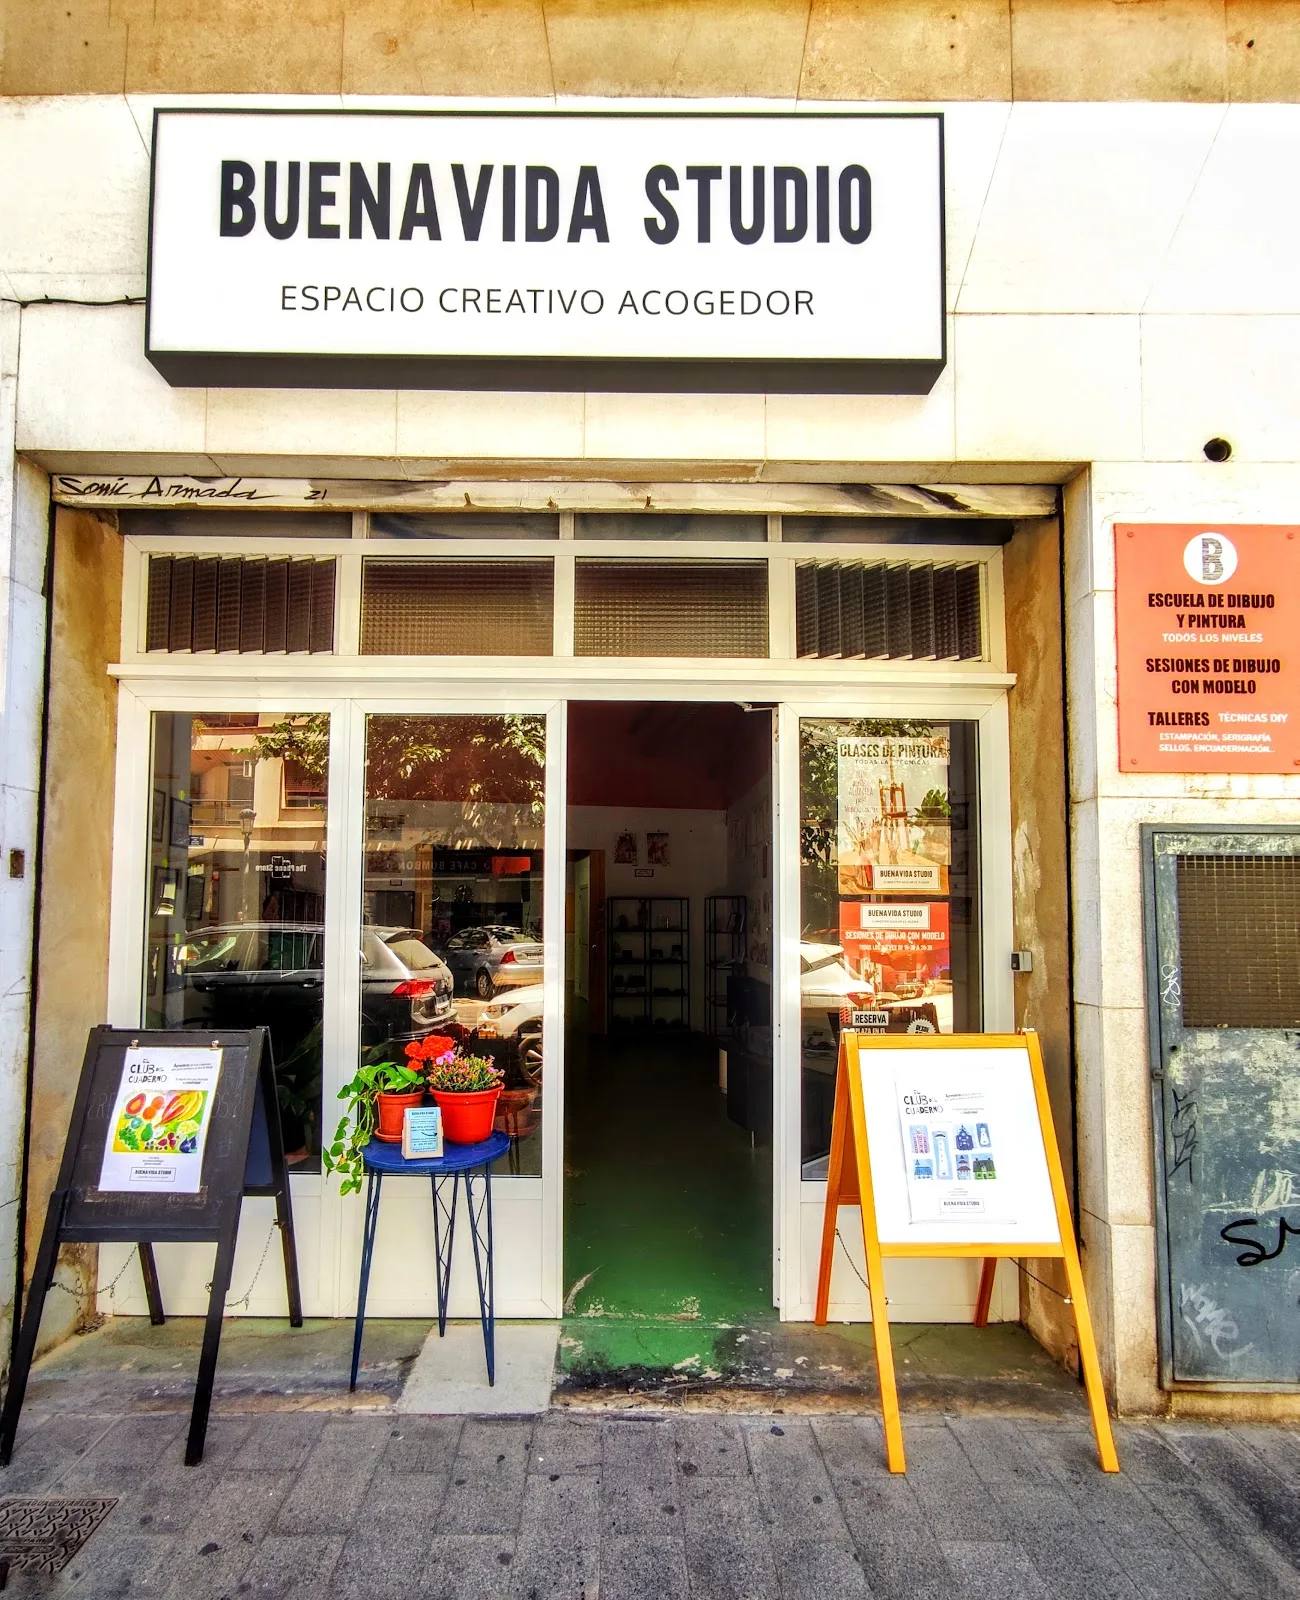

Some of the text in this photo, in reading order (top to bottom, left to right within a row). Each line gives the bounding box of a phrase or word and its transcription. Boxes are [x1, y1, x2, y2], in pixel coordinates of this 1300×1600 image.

[219, 159, 874, 246] BUENAVIDA STUDIO
[281, 285, 815, 316] ESPACIO CREATIVO ACOGEDOR
[1201, 537, 1224, 581] B
[1148, 593, 1275, 609] ESCUELA DE DIBUJO
[1176, 614, 1246, 629] Y PINTURA
[1162, 633, 1263, 643] TODOS LOS NIVELES
[1146, 658, 1281, 674] SESIONES DE DIBUJO
[1172, 680, 1256, 694] CON MODELO
[1148, 711, 1288, 727] TALLERES TÉCNICAS DIY
[840, 744, 880, 757] CLASES
[882, 745, 896, 758] DE
[880, 870, 933, 878] BUENAVIDA STUDIO
[868, 909, 901, 917] BUENAVIDA
[921, 932, 945, 940] MODELO
[855, 1014, 887, 1024] RESERVA
[130, 1064, 155, 1074] CLUB
[128, 1075, 168, 1083] CUADERNO
[903, 1094, 929, 1106] CLUB
[905, 1105, 944, 1115] CUADERNO
